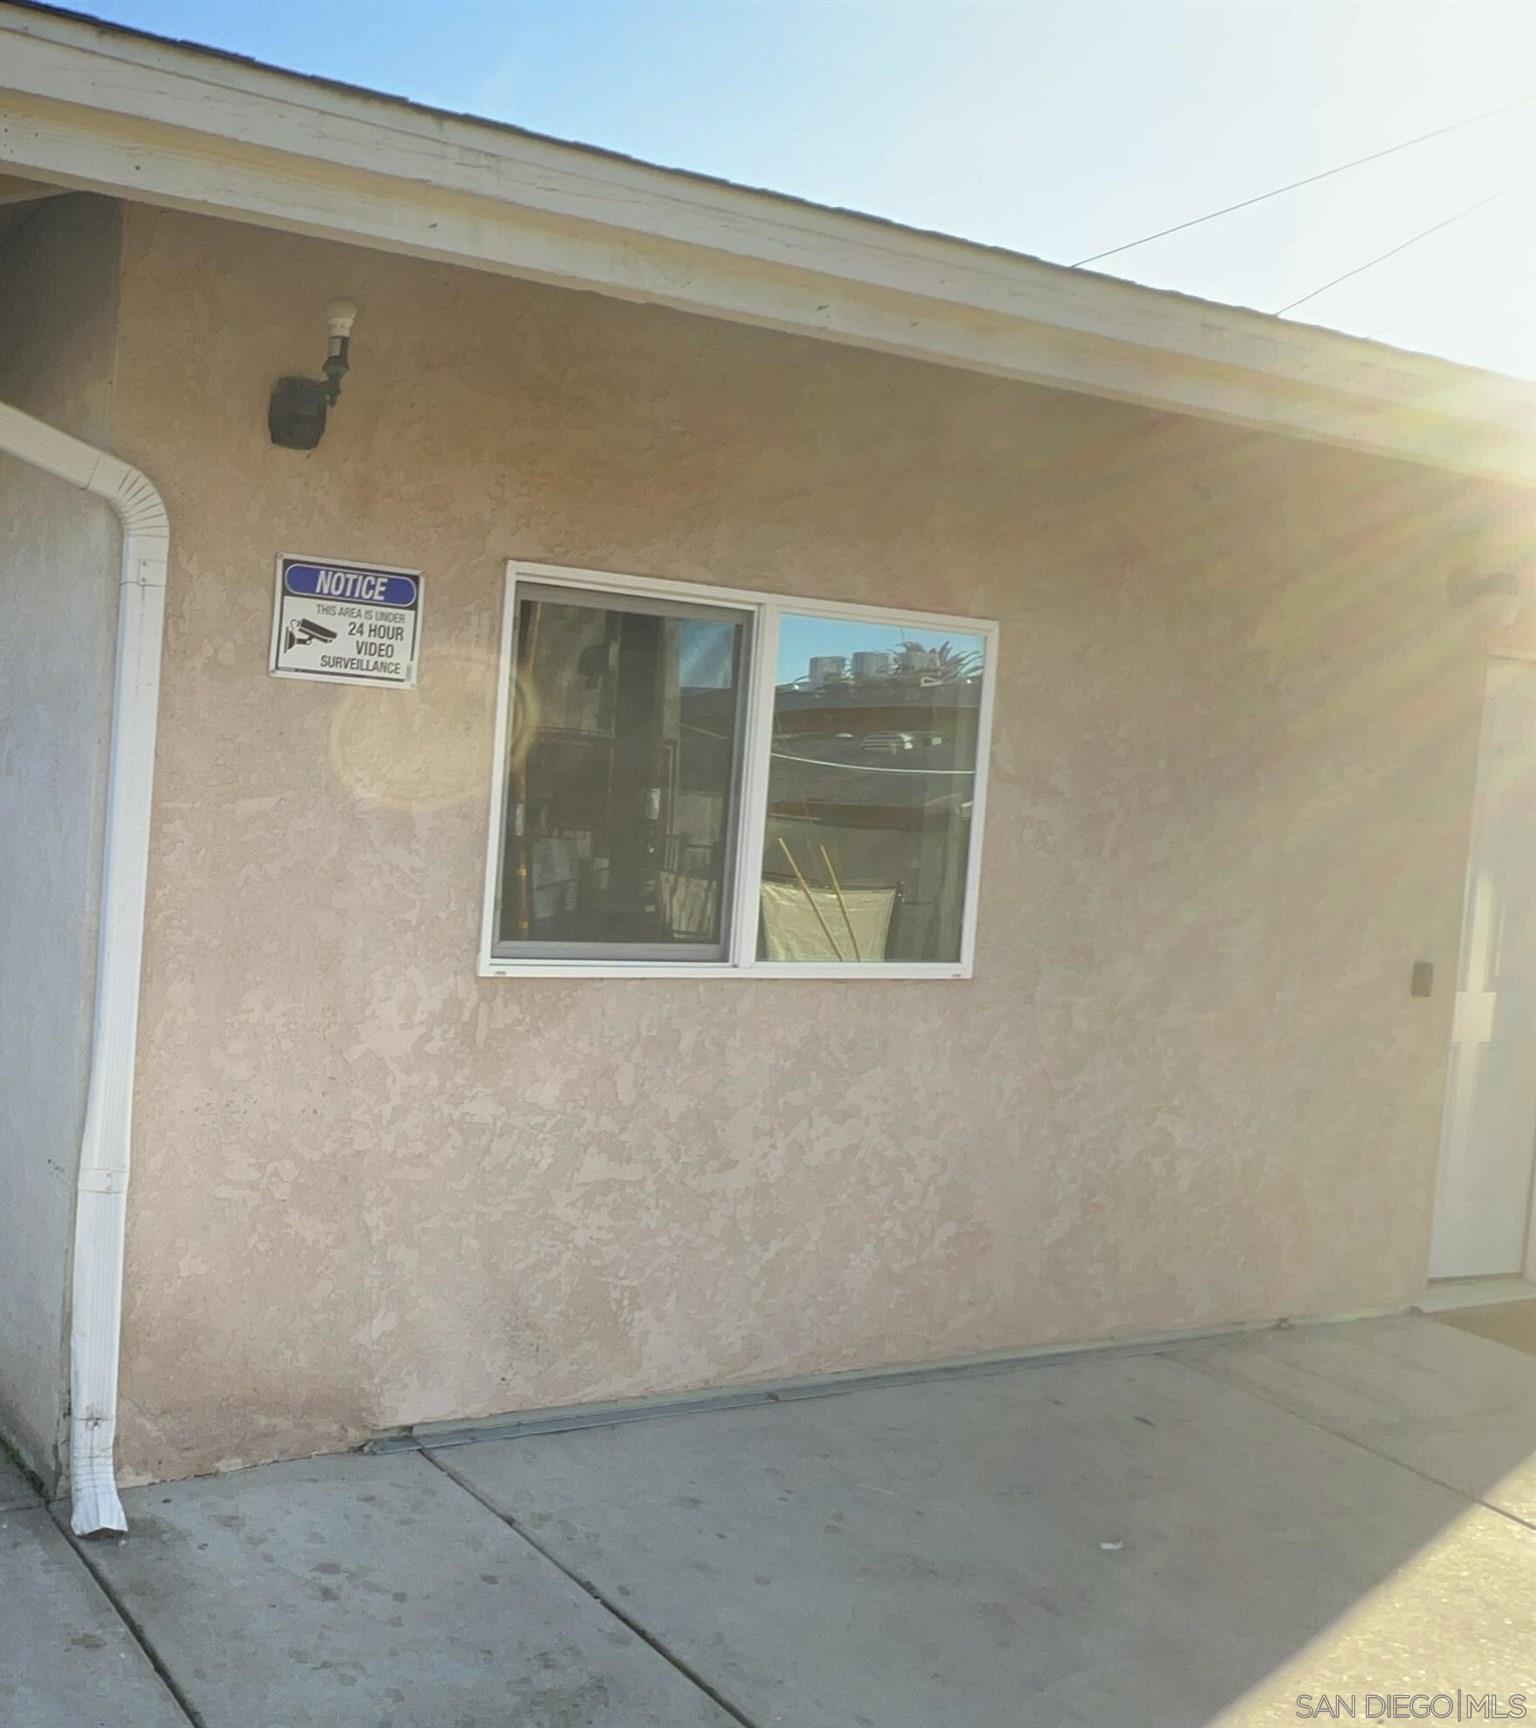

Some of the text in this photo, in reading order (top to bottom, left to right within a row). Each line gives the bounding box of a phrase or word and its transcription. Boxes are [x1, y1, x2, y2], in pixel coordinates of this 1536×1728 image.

[315, 570, 389, 601] NOTICE
[316, 603, 406, 624] THIS AREA IS UNDER
[348, 622, 405, 641] 24 HOUR
[356, 641, 395, 658] VIDEO
[320, 655, 401, 675] SURVEILLANCE
